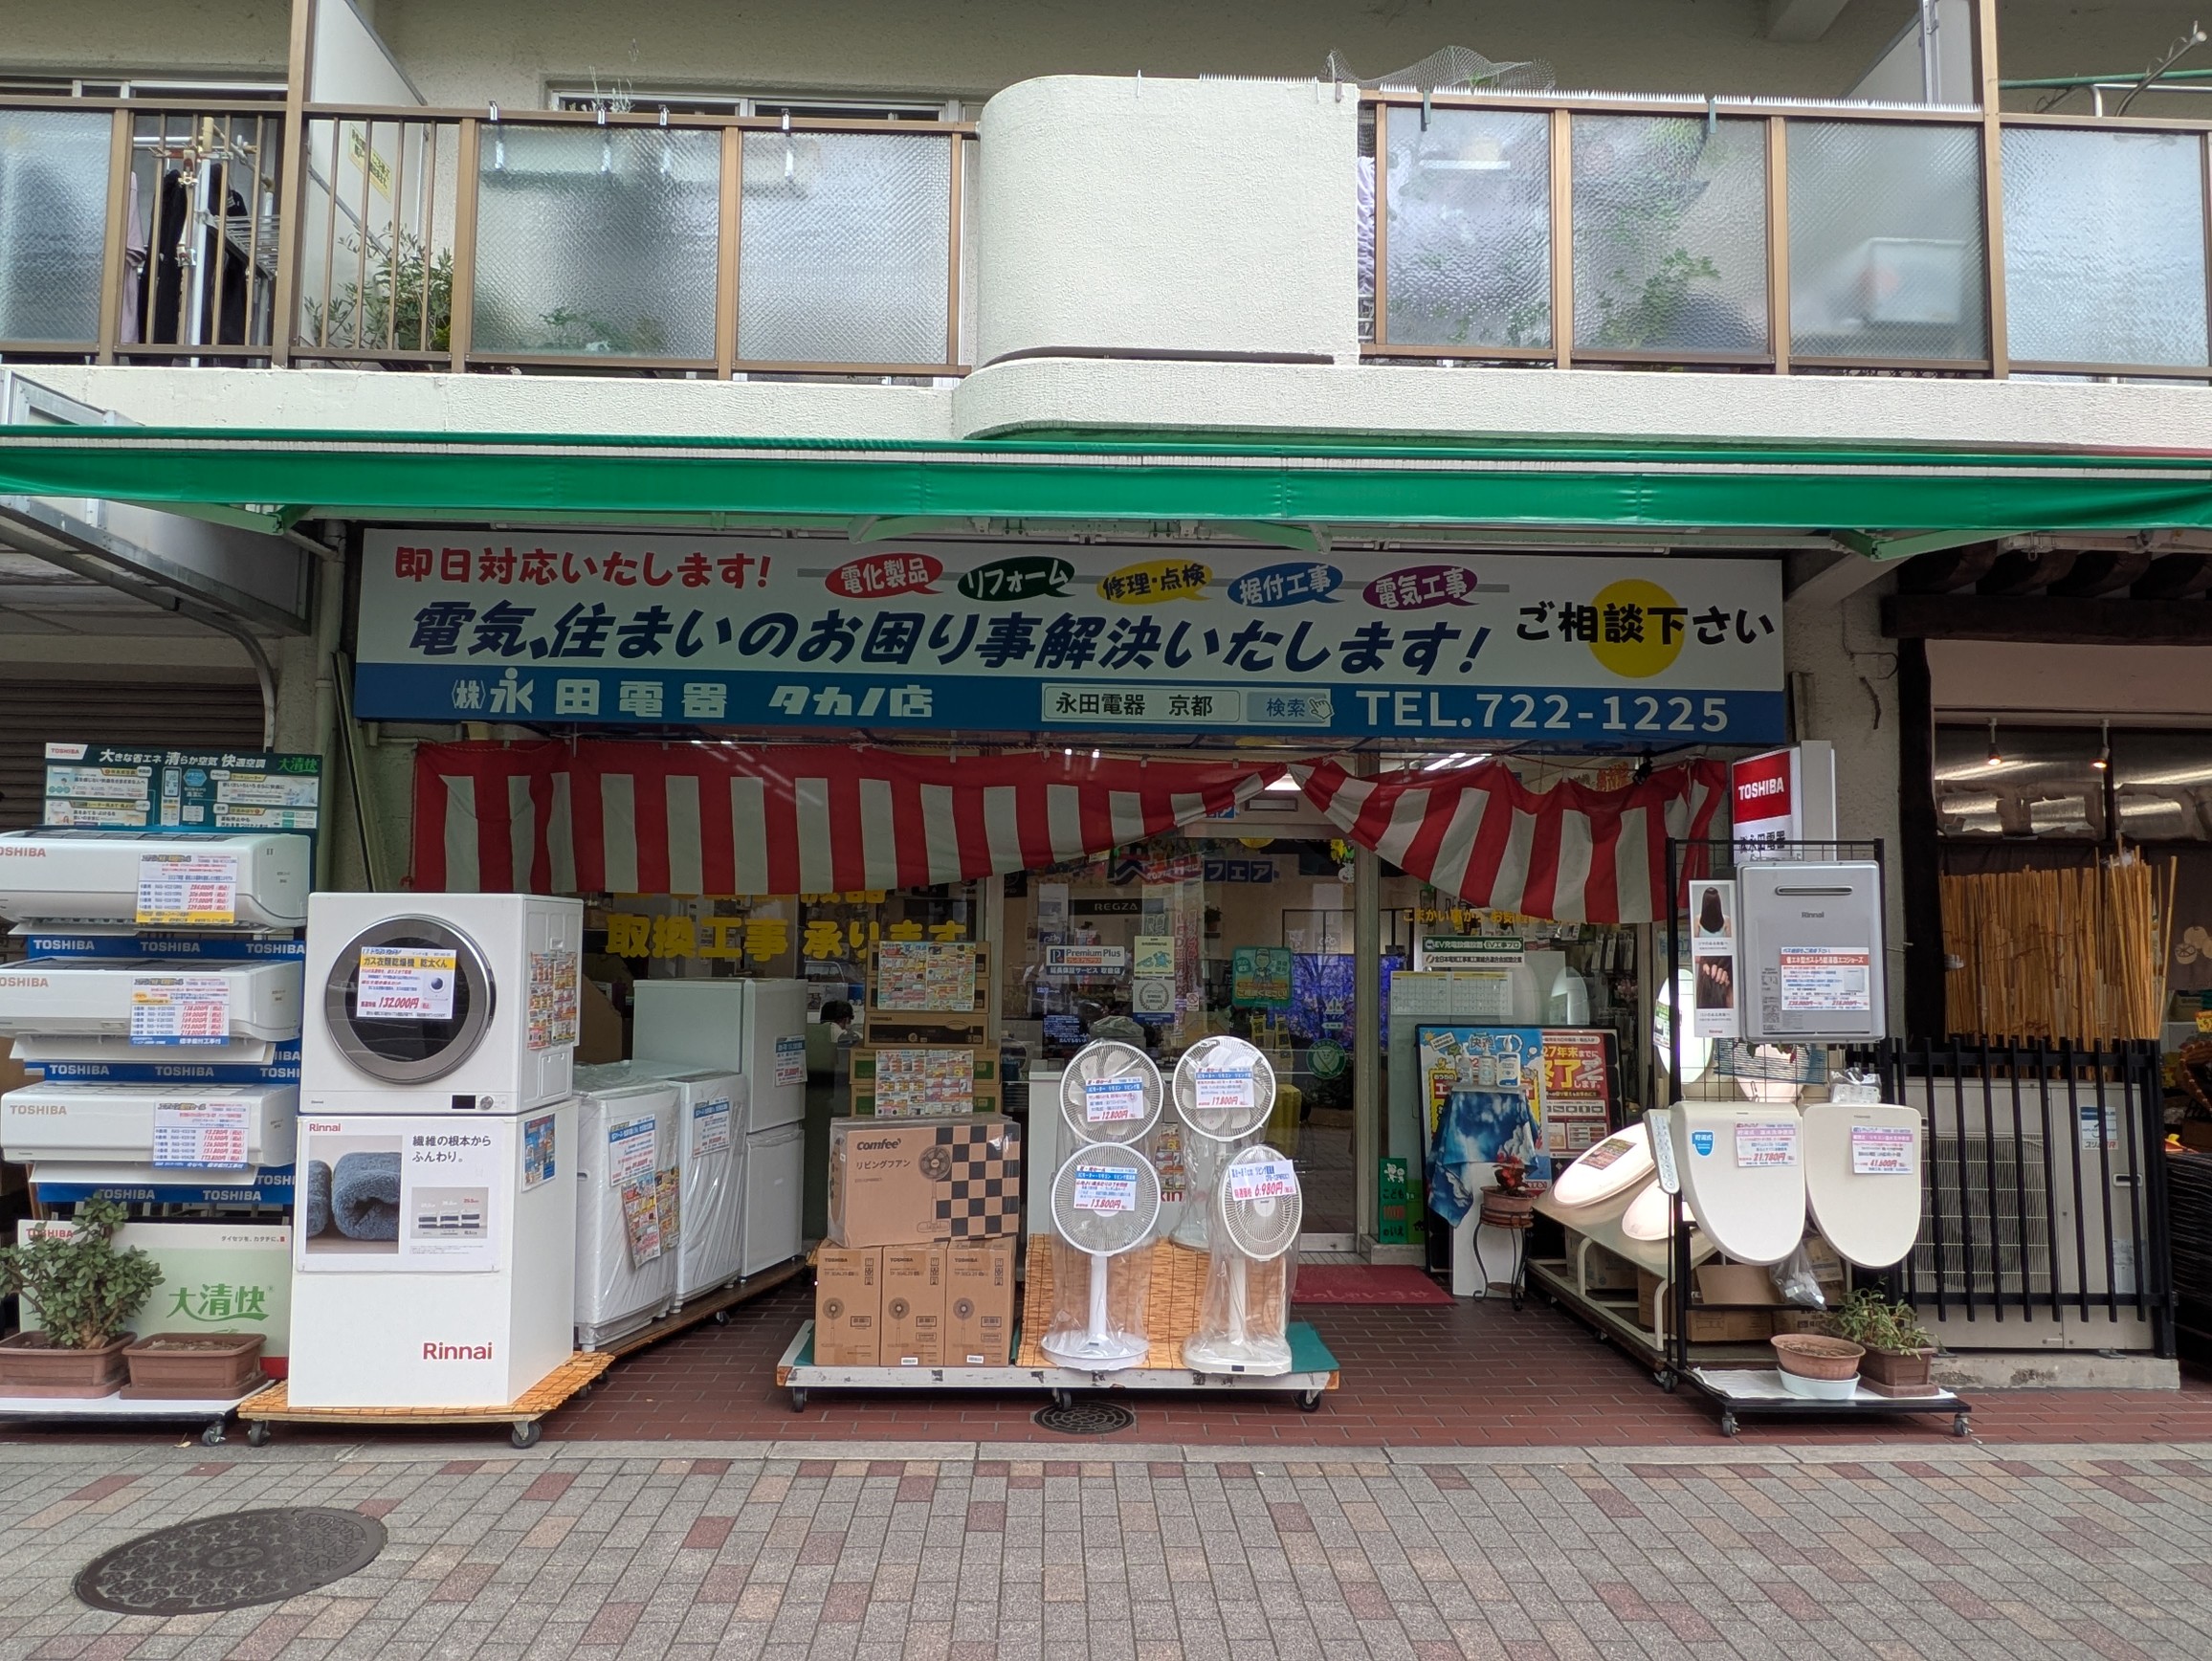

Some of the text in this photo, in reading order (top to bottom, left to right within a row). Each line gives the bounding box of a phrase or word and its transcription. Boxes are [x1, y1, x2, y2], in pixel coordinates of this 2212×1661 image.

[394, 547, 771, 590] 即日対応いたします!
[840, 557, 930, 595] 電化製品
[966, 560, 1073, 598] リフォーム
[1101, 562, 1207, 602] 修理・点検
[1238, 565, 1334, 608] 据付工事
[1374, 567, 1470, 609] 電気工事
[1516, 602, 1776, 647] ご相談下さい
[768, 684, 935, 720] タカノ店
[1055, 692, 1213, 719] 永田電器 京都
[1266, 698, 1306, 719] 検索
[1356, 689, 1729, 734] TEL.722-1225
[51, 747, 80, 756] TOSHIBA
[99, 748, 267, 769] 大きな省エネ 清らか空気 快適空調
[278, 757, 320, 773] 大清快
[1737, 776, 1785, 802] TOSHIBA
[0, 847, 47, 858] OSHIBA
[1207, 861, 1272, 881] フェア
[1095, 902, 1139, 912] REGZA
[33, 939, 95, 951] TOSHIBA
[604, 915, 789, 963] 取換工事
[140, 941, 201, 953] TOSHIBA
[246, 942, 305, 955] TOSHIBA
[1066, 948, 1121, 958] Premium Plus
[364, 957, 415, 967] ガス衣類乾燥機
[0, 977, 49, 987] OSHIBA
[1541, 1045, 1599, 1058] 27年末までに
[50, 1064, 110, 1075] TOSHIBA
[155, 1066, 214, 1077] TOSHIBA
[260, 1067, 300, 1079] TOSHI
[10, 1104, 67, 1116] TOSHIBA
[308, 1122, 342, 1133] Rinnai
[412, 1135, 492, 1147] 繊維の根本から
[412, 1151, 464, 1163] ふんわり。
[257, 1175, 296, 1186] TOSHI
[100, 1189, 156, 1201] TOSHIBA
[203, 1190, 262, 1202] TOSHIBA
[1382, 1187, 1405, 1200] こども
[166, 1283, 270, 1322] 大清快
[422, 1340, 494, 1361] Rinnai
